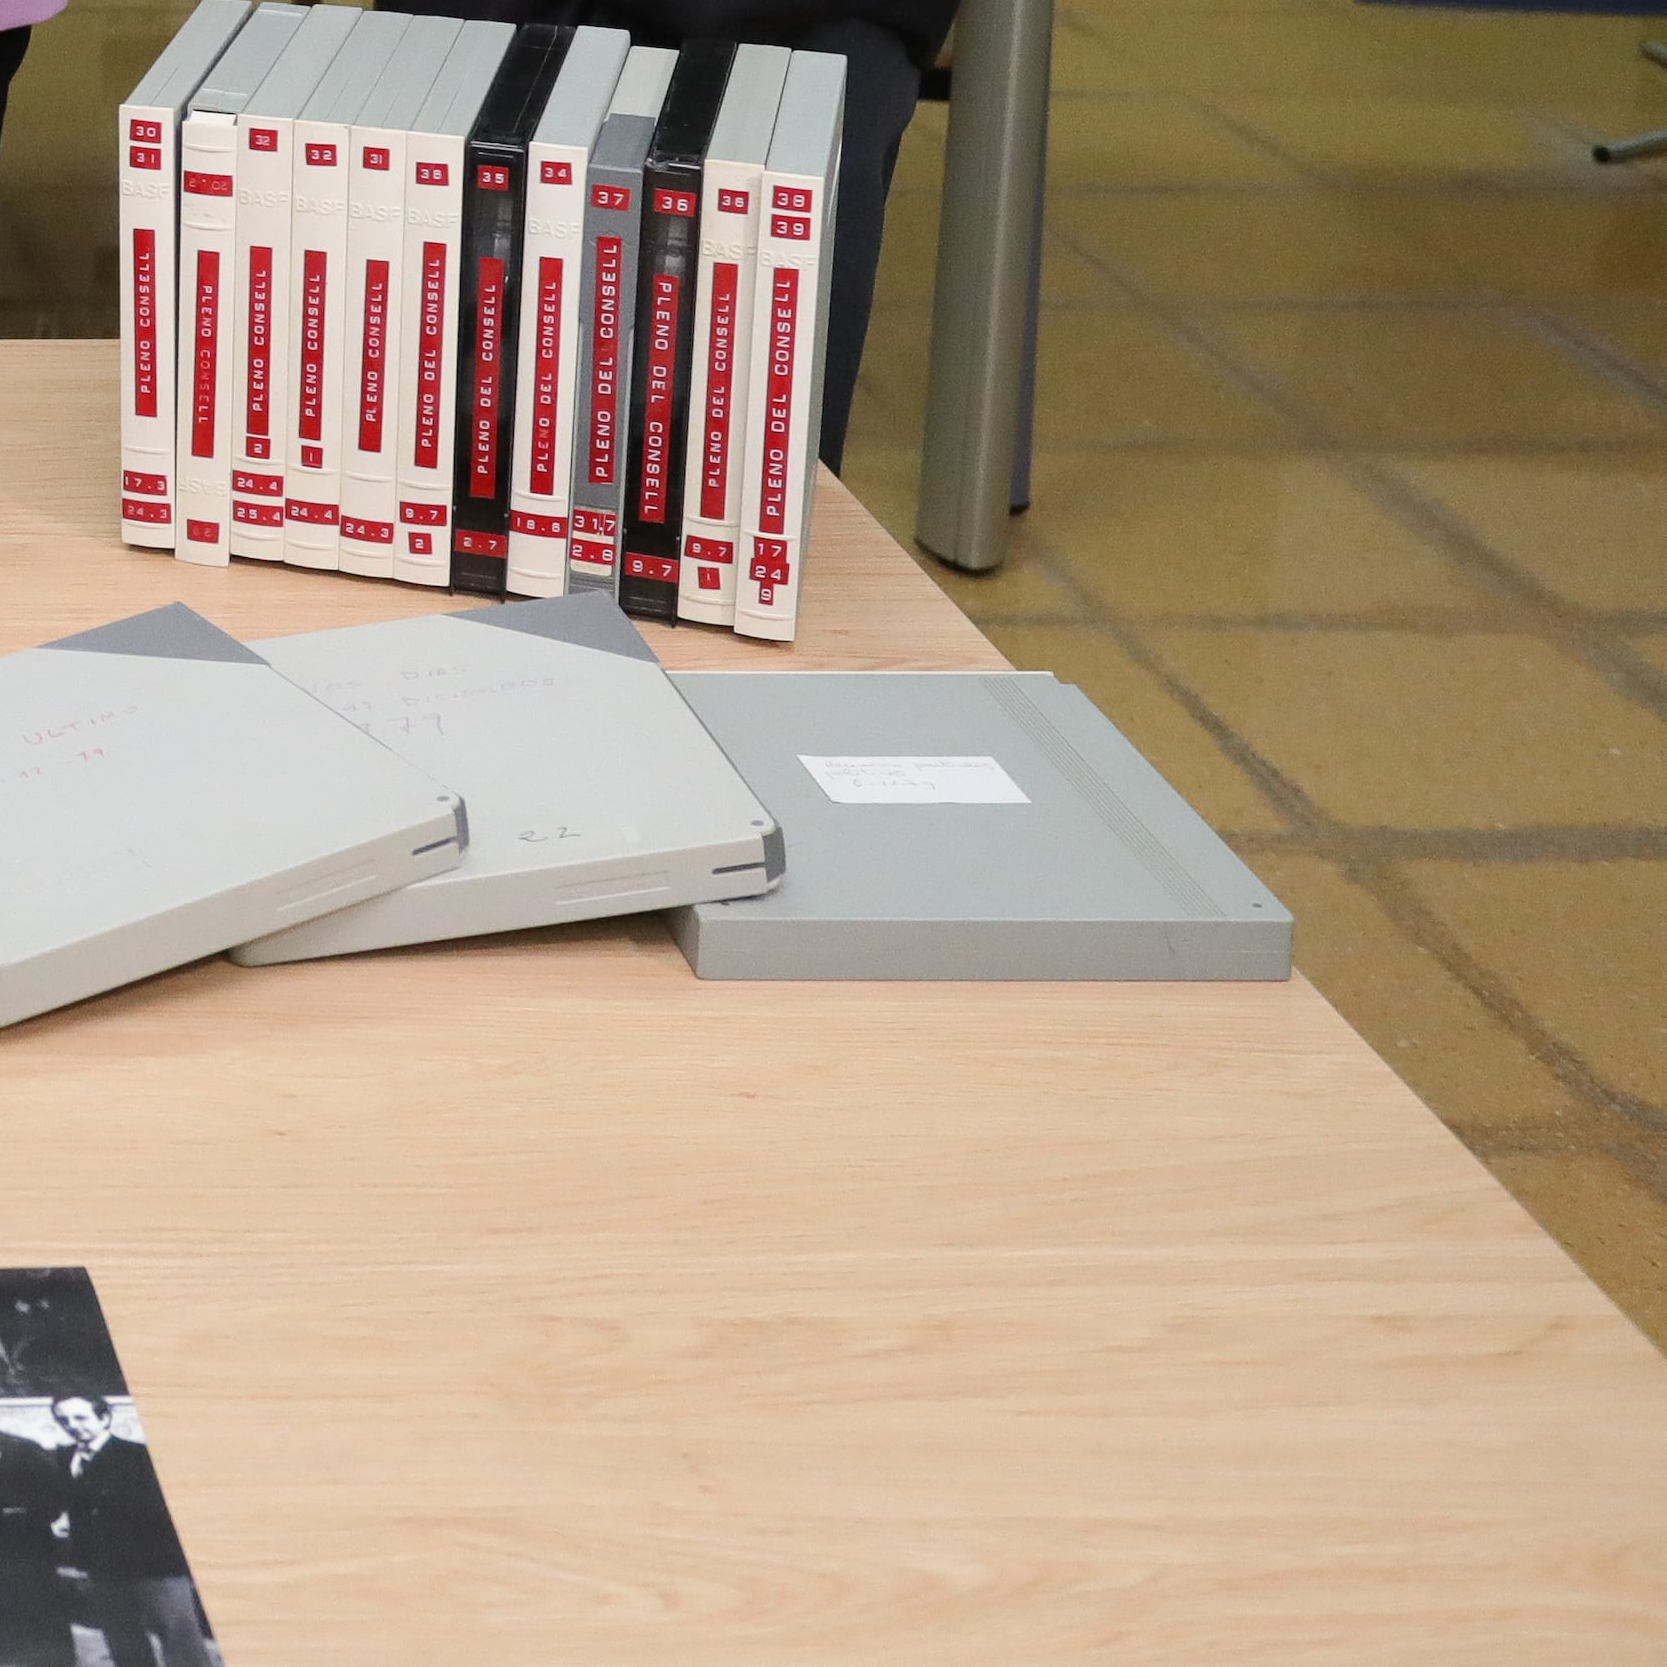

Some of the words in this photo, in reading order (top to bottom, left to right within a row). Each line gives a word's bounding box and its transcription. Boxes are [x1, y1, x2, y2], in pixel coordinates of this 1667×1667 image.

[135, 126, 156, 138] 30
[255, 134, 271, 147] 32
[135, 151, 156, 164] 31
[310, 149, 333, 161] 32
[369, 153, 383, 165] 31
[482, 171, 505, 184] 35
[544, 166, 567, 178] 34
[596, 191, 624, 206] 37
[661, 195, 689, 212] 36
[776, 192, 807, 208] 38
[776, 220, 806, 236] 39
[139, 252, 152, 328] CONSELL
[426, 258, 441, 336] CONSELL
[599, 244, 618, 340] CONSELL
[200, 285, 213, 338] PLENO
[254, 269, 266, 346] CONSELL
[307, 274, 320, 351] CONSELL
[368, 282, 382, 359] CONSELL
[482, 284, 498, 362] CONSELL
[542, 281, 559, 359] CONSELL
[655, 281, 673, 351] PLENO
[715, 293, 731, 372] CONSELL
[774, 280, 792, 376] CONSELL
[139, 339, 151, 394] PLENO
[424, 349, 436, 382] DEL
[598, 356, 613, 395] DEL
[252, 357, 264, 412] PLENO
[305, 363, 317, 418] PLENO
[366, 370, 379, 423] PLENO
[480, 375, 493, 408] DEL
[540, 372, 552, 405] DEL
[651, 365, 668, 404] DEL
[712, 385, 725, 419] DEL
[771, 393, 787, 433] DEL
[421, 393, 434, 448] PLENO
[253, 443, 263, 454] 2
[477, 419, 490, 475] PLENO
[595, 410, 612, 478] PLENO
[708, 431, 723, 488] PLENO
[124, 476, 166, 491] 17.3
[237, 477, 278, 491] 24.4
[643, 421, 664, 514] CONSELL
[766, 448, 785, 517] PLENO
[236, 508, 281, 522] 25.4
[290, 505, 333, 520] 24.4
[345, 523, 390, 538] 24.3
[415, 538, 424, 549] 2
[571, 544, 614, 562] 2.8
[757, 542, 783, 557] 17
[632, 559, 673, 578] 9.7
[754, 564, 782, 581] 24
[761, 588, 771, 601] 9
